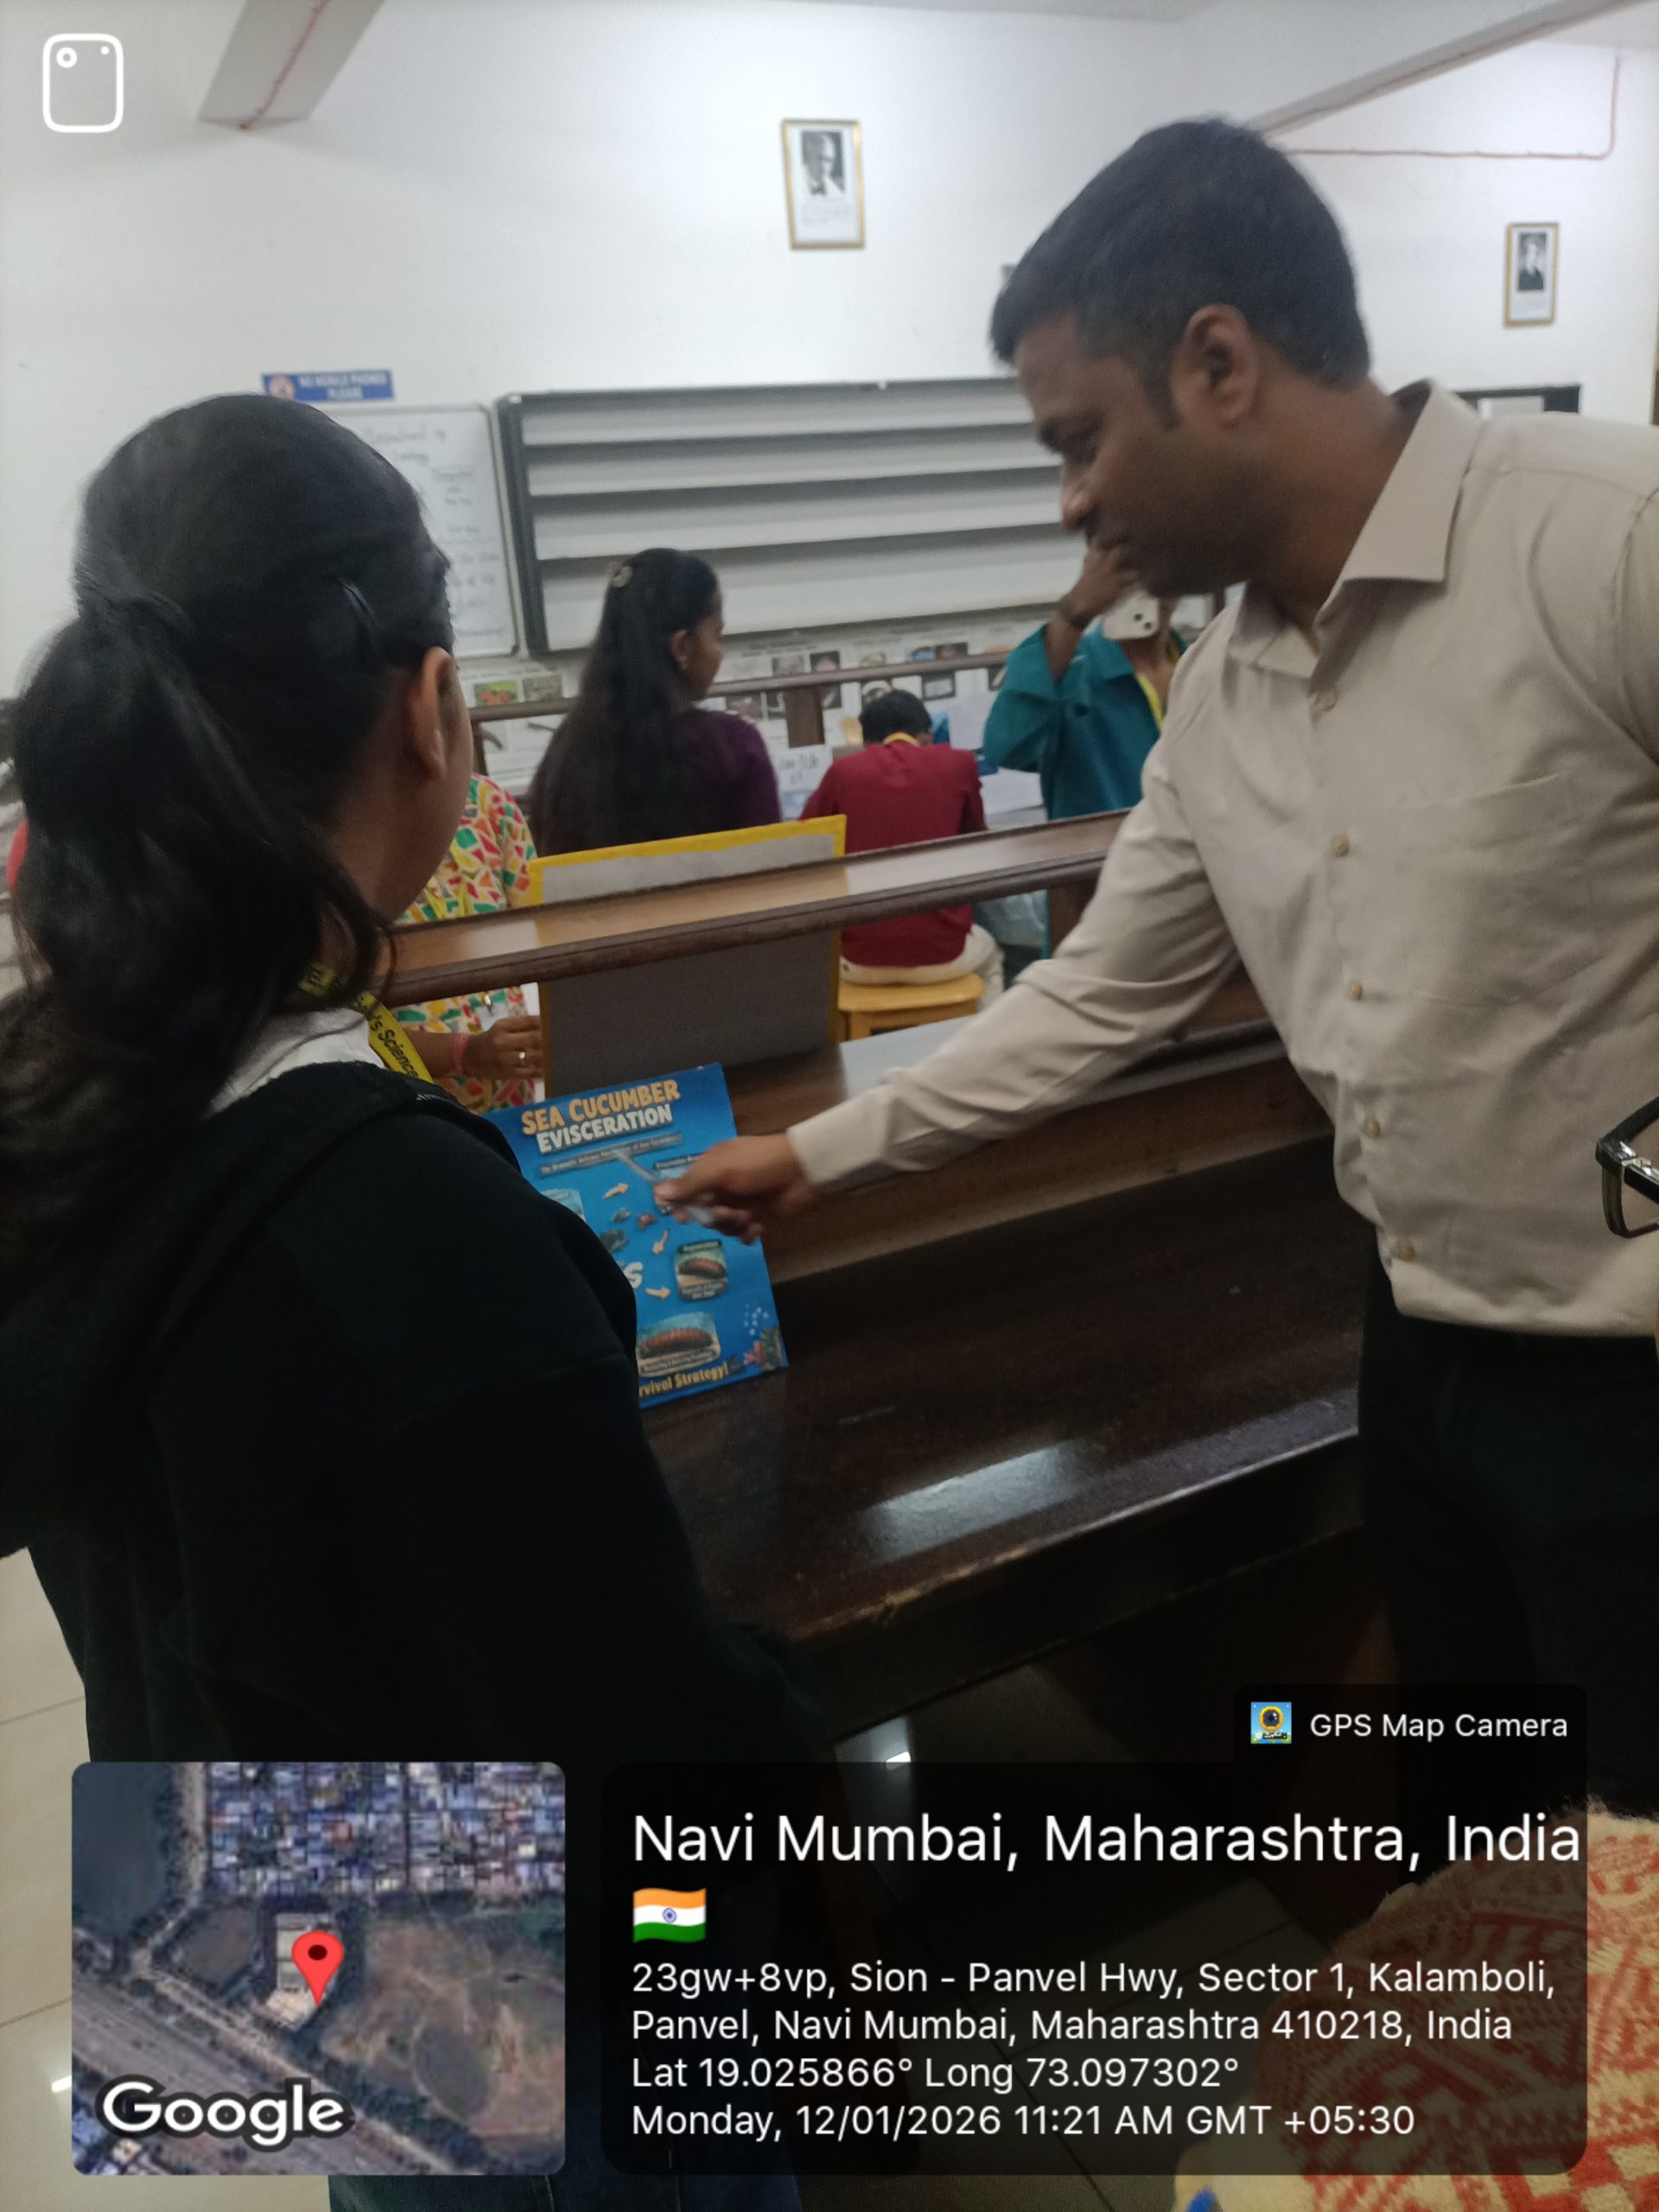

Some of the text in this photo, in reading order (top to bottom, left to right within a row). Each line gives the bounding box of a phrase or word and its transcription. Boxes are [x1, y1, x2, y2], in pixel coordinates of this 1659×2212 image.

[521, 1079, 681, 1135] SEA CUCUMBER
[537, 1103, 673, 1154] EVISCERATION
